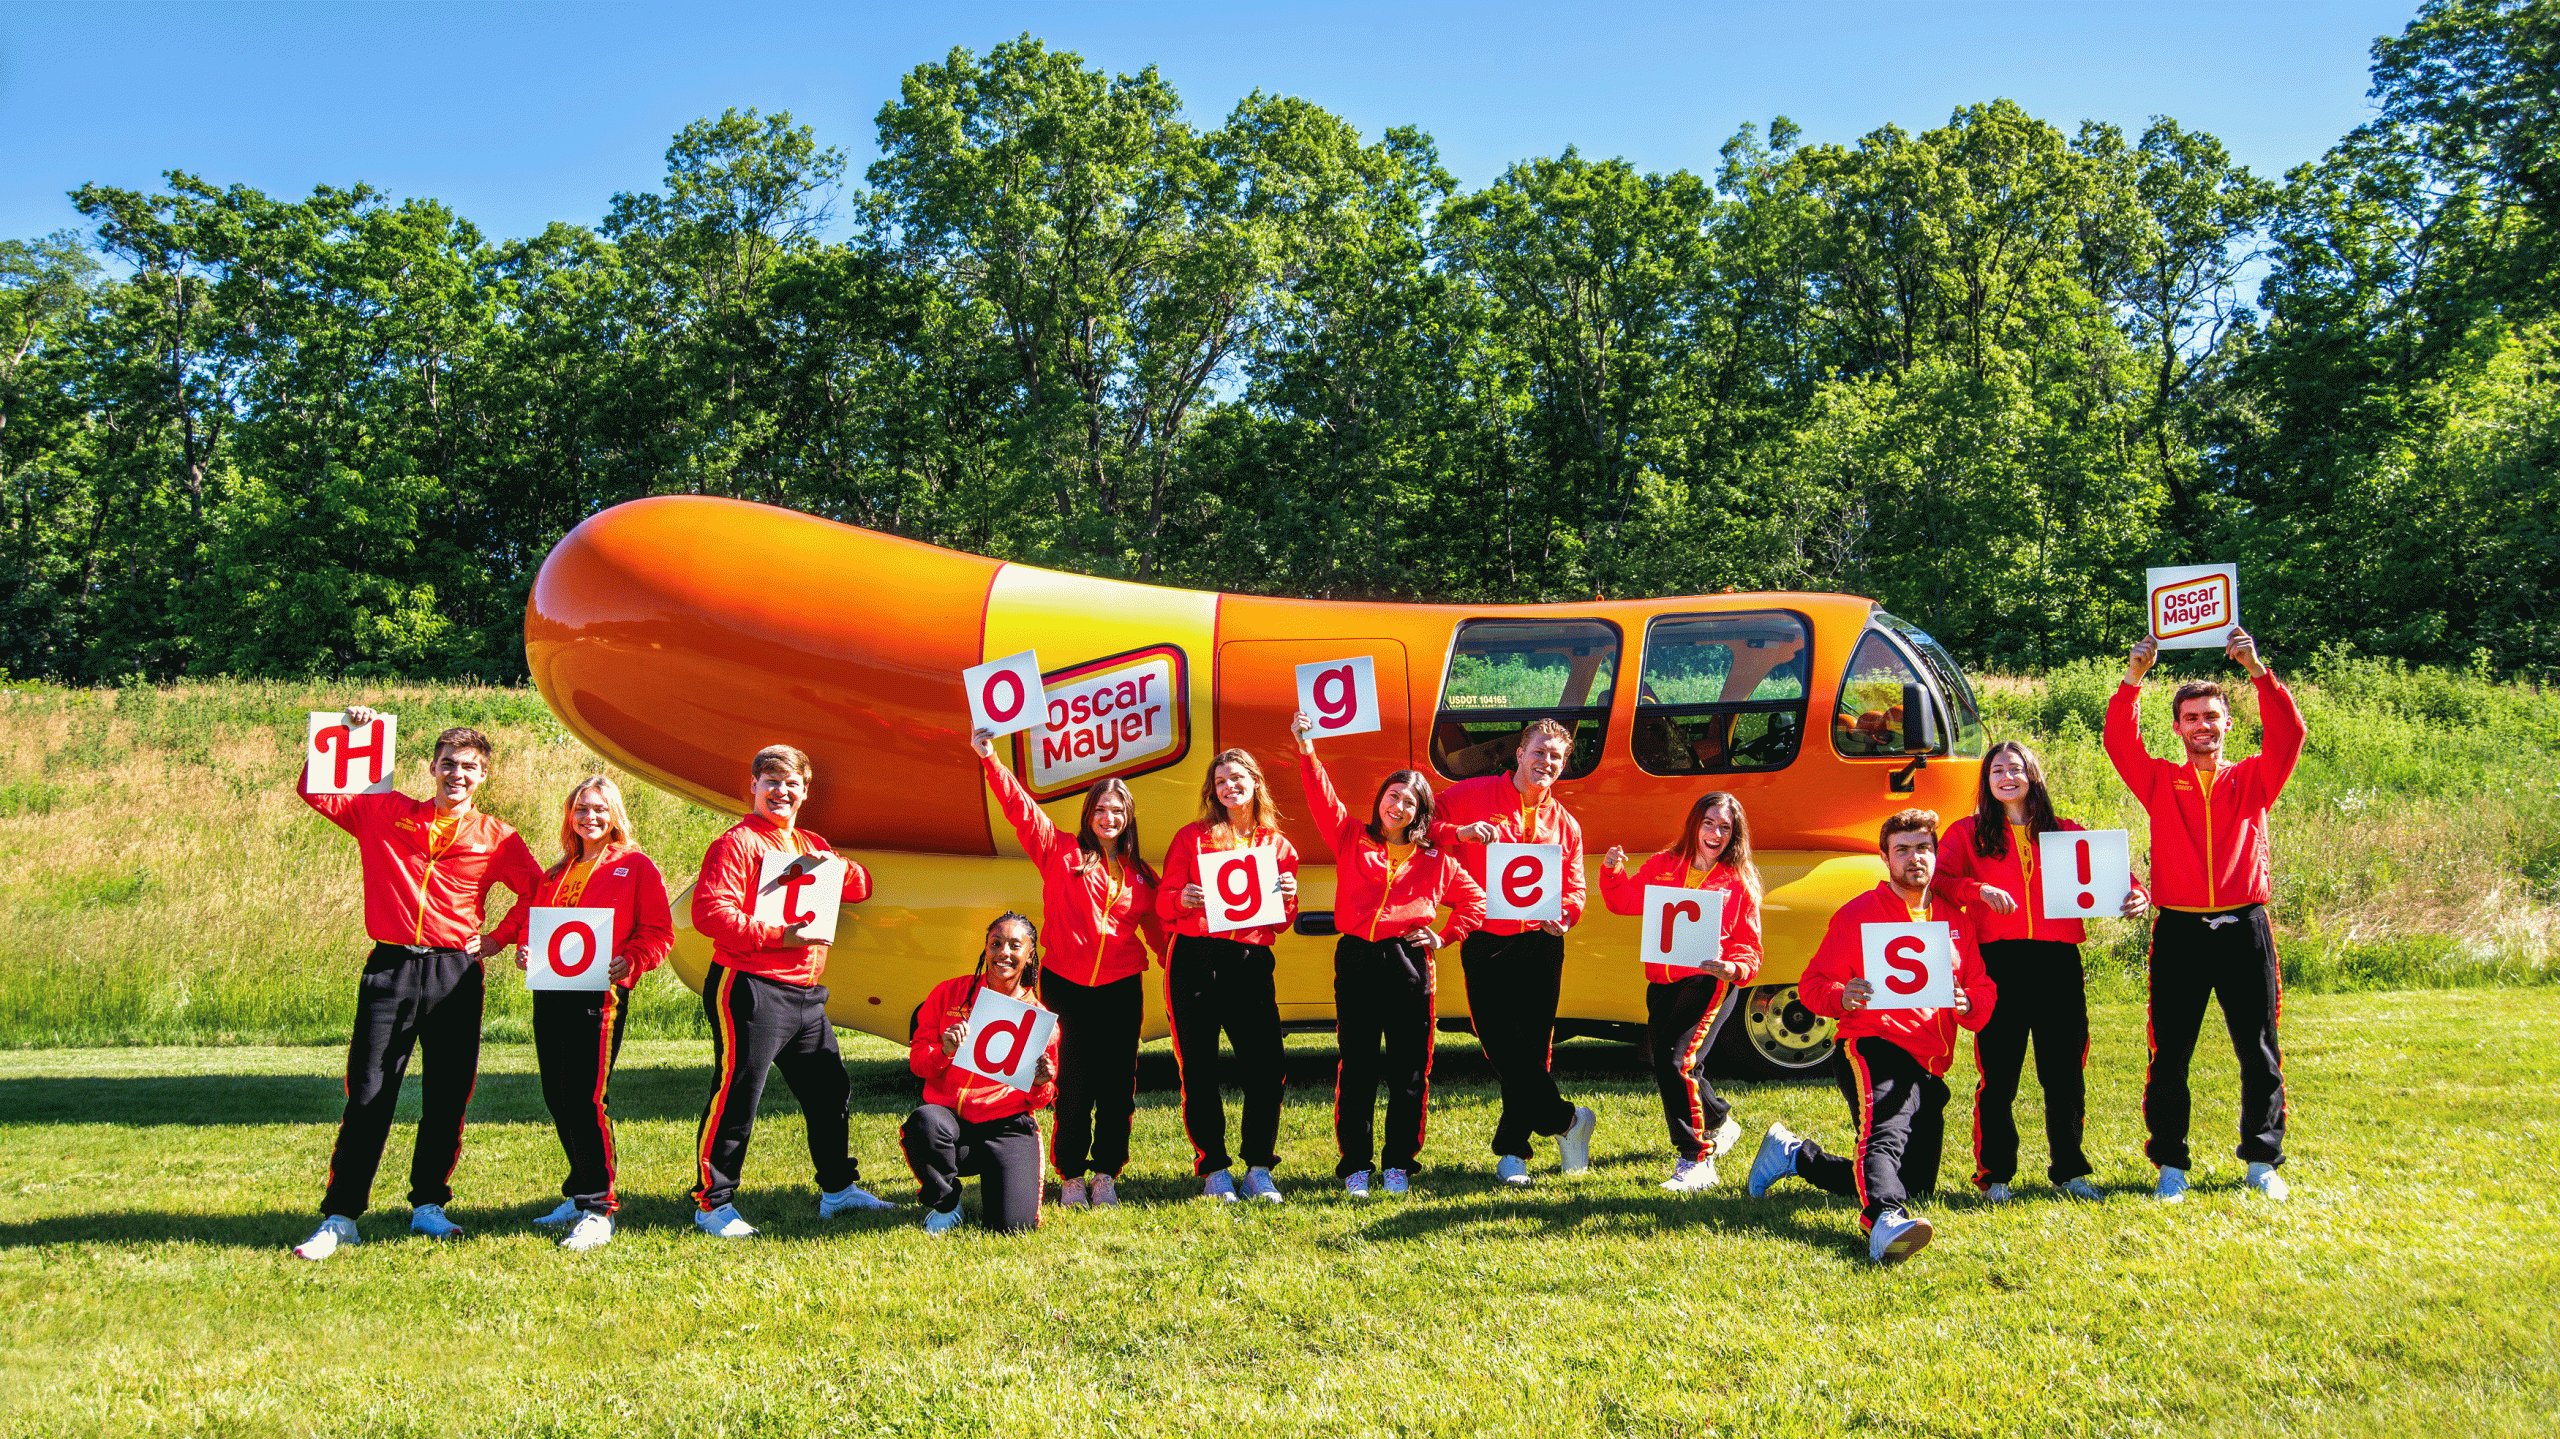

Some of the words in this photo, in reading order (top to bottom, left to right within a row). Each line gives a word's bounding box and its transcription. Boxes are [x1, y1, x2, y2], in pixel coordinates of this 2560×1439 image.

[2163, 601, 2220, 626] Mayer
[2164, 586, 2217, 610] Oscar
[1045, 673, 1156, 732] Oscar
[1312, 664, 1358, 730] g
[1449, 695, 1478, 704] USDOT
[1479, 695, 1507, 704] 104165
[314, 719, 385, 789] H
[1042, 704, 1161, 769] Mayer
[777, 863, 817, 926] t
[1216, 854, 1262, 922] g
[1501, 855, 1544, 908] e
[2075, 839, 2096, 910] !
[1660, 899, 1701, 954] r
[1884, 935, 1929, 995] s
[973, 1009, 1037, 1077] d
